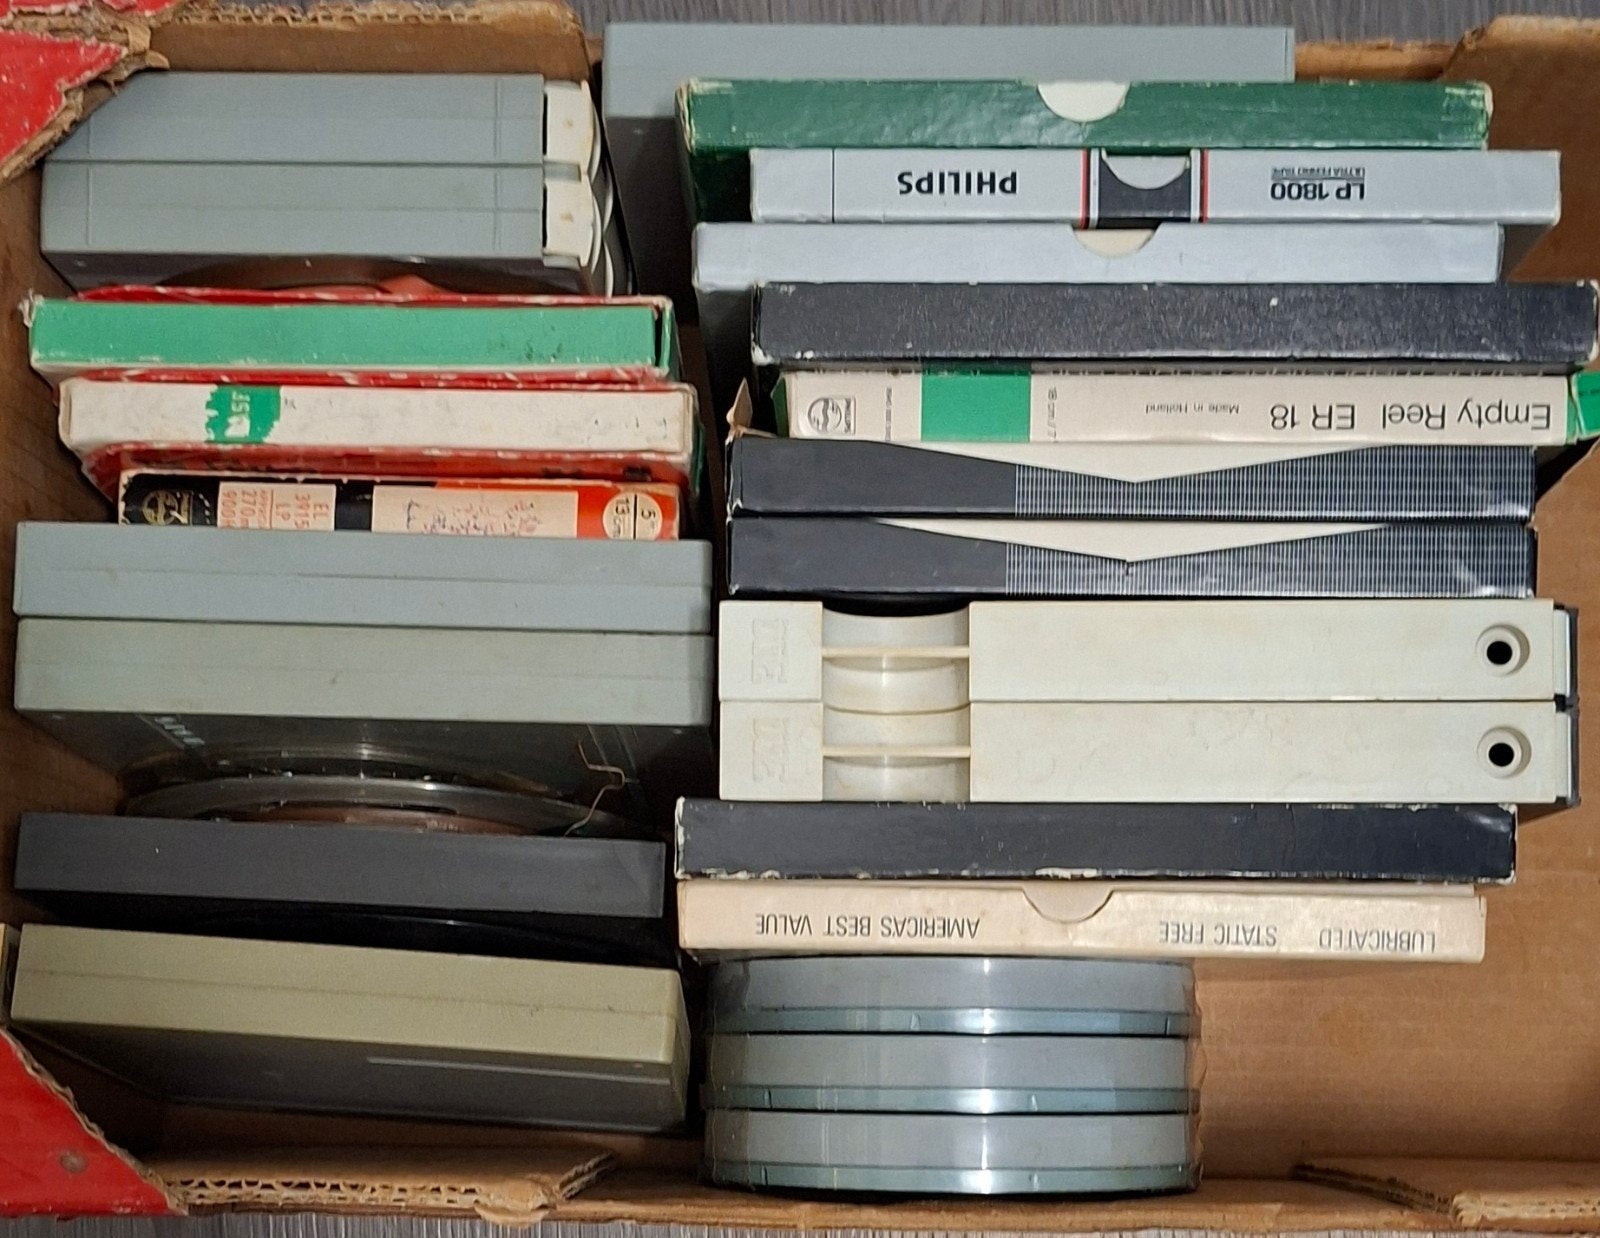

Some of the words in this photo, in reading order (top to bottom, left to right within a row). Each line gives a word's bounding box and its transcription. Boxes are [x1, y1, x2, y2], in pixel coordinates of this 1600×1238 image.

[897, 171, 1017, 195] PHILIPS
[1270, 183, 1329, 200] 1800
[1335, 183, 1365, 200] LP
[1145, 404, 1187, 415] Holland
[1193, 403, 1203, 414] in
[1207, 404, 1239, 415] Made
[1270, 404, 1300, 430] 18
[1311, 404, 1355, 430] ER
[1382, 404, 1446, 430] Reel
[1456, 398, 1551, 430] Empty
[312, 502, 330, 520] EL
[755, 912, 813, 936] VALUE
[824, 914, 871, 937] BEST
[880, 915, 981, 939] AMERICA'S
[1158, 920, 1204, 944] FREE
[1213, 922, 1277, 947] STATIC
[1318, 927, 1436, 953] LUBRICATED
